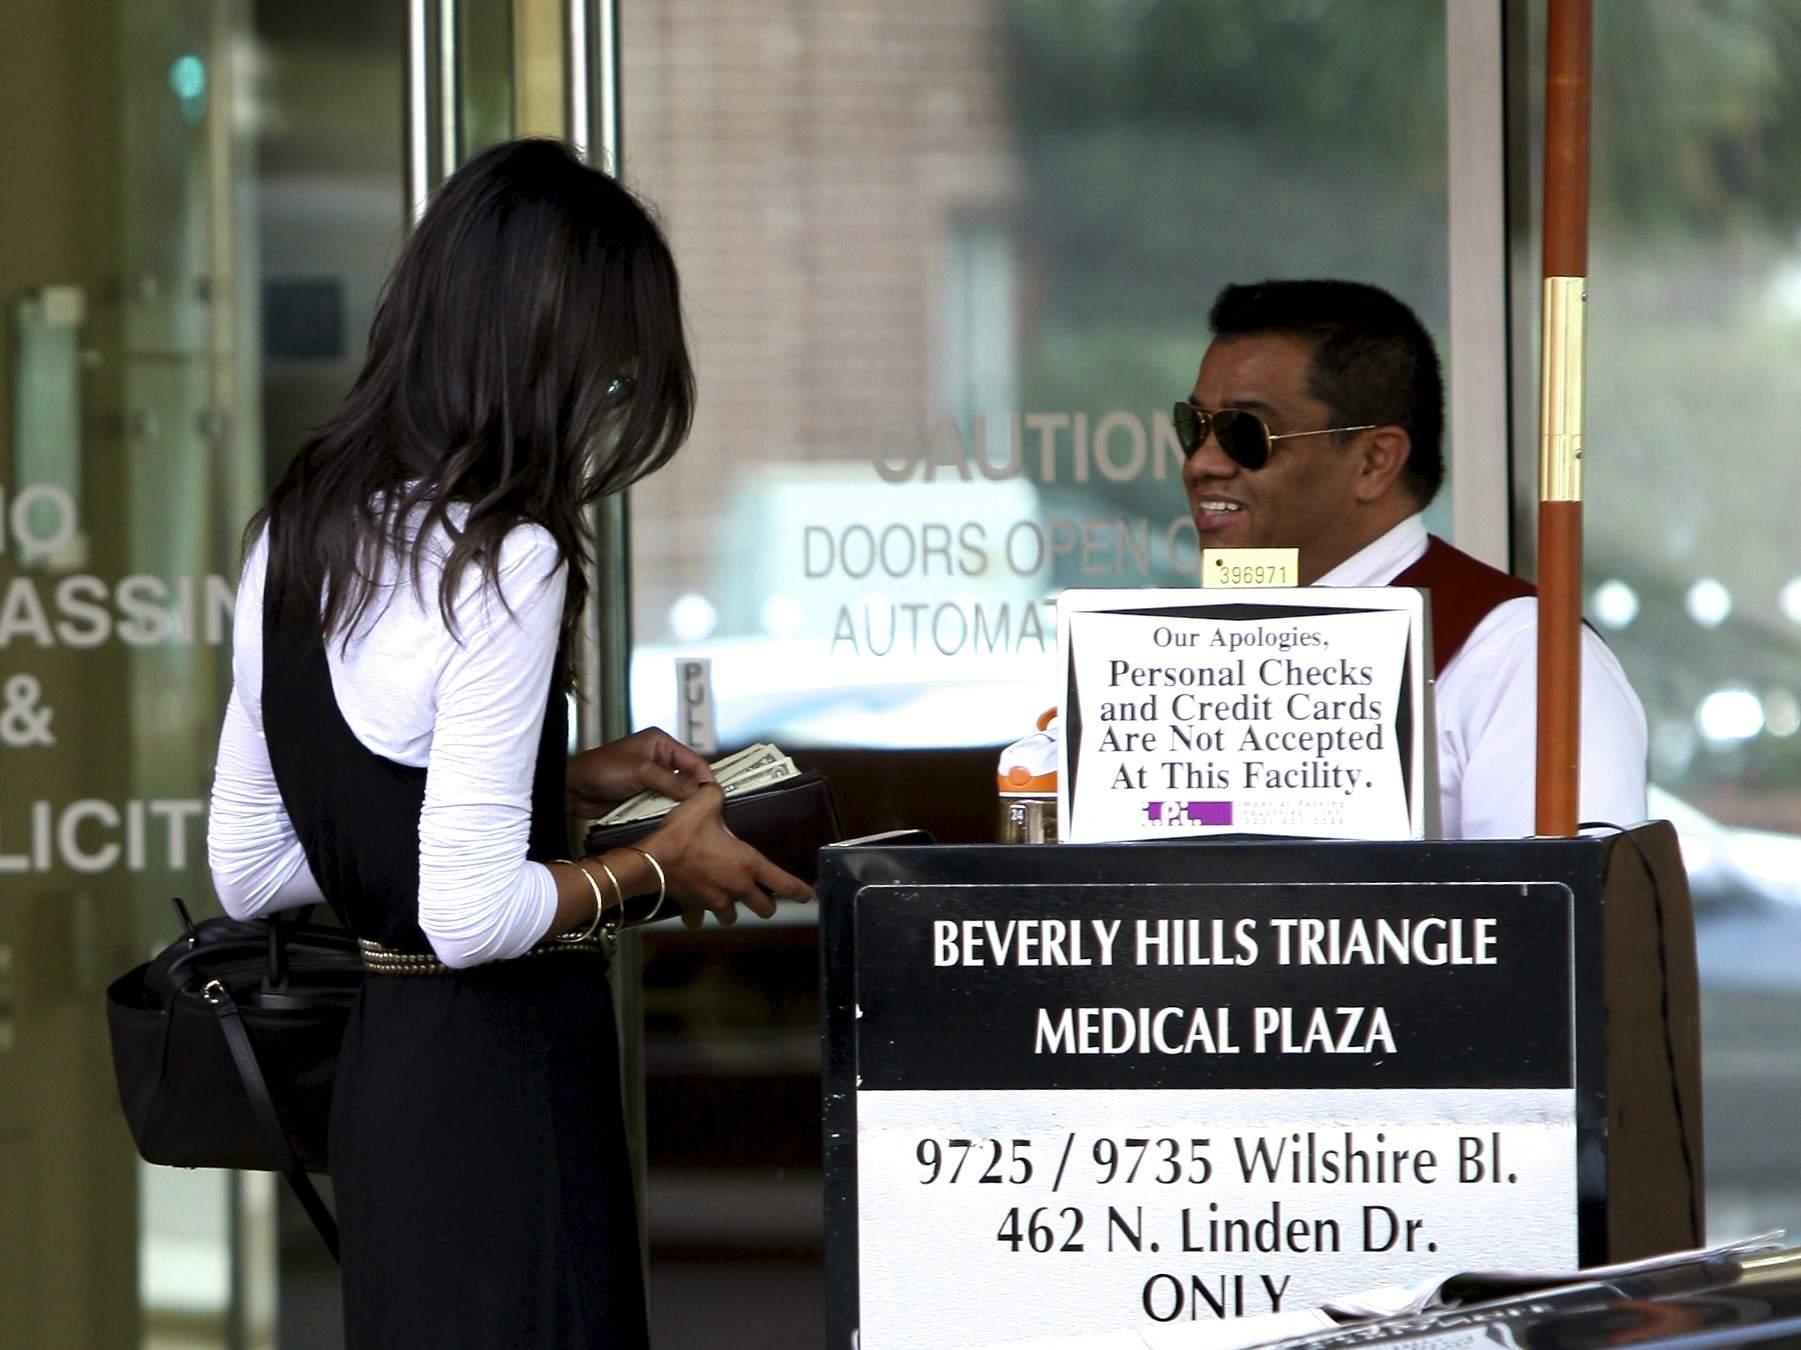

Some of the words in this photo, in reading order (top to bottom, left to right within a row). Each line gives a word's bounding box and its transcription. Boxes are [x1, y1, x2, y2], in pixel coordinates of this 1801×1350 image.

[0, 483, 77, 554] O
[804, 521, 989, 580] DOORS
[1006, 520, 1150, 577] OPEN
[1220, 566, 1286, 585] 396971
[1153, 627, 1200, 648] Our
[1209, 626, 1329, 653] Apologies,
[1108, 659, 1245, 688] Personal
[1259, 658, 1373, 687] Checks
[0, 673, 56, 748] &
[1100, 694, 1158, 722] and
[1171, 693, 1273, 722] Credit
[1286, 692, 1382, 722] Cards
[1098, 725, 1157, 754] Are
[1169, 724, 1224, 753] Not
[1239, 723, 1384, 759] Accepted
[1111, 763, 1147, 790] At
[1161, 761, 1230, 790] This
[1243, 761, 1373, 796] Facility.
[933, 919, 1122, 967] BEVERLY
[1135, 918, 1259, 966] HILLS
[1270, 917, 1498, 966] TRIANGLE
[1034, 1006, 1240, 1055] MEDICAL
[1254, 1006, 1398, 1054] PLAZA
[916, 1138, 1033, 1185] 9725
[1052, 1132, 1075, 1192] /
[1092, 1138, 1211, 1185] 9735
[1234, 1132, 1437, 1185] Wilshire
[1459, 1132, 1518, 1185] Bl.
[997, 1207, 1084, 1253] 462
[1107, 1206, 1160, 1253] N.
[1182, 1201, 1340, 1253] Linden
[1363, 1205, 1438, 1253] Dr.
